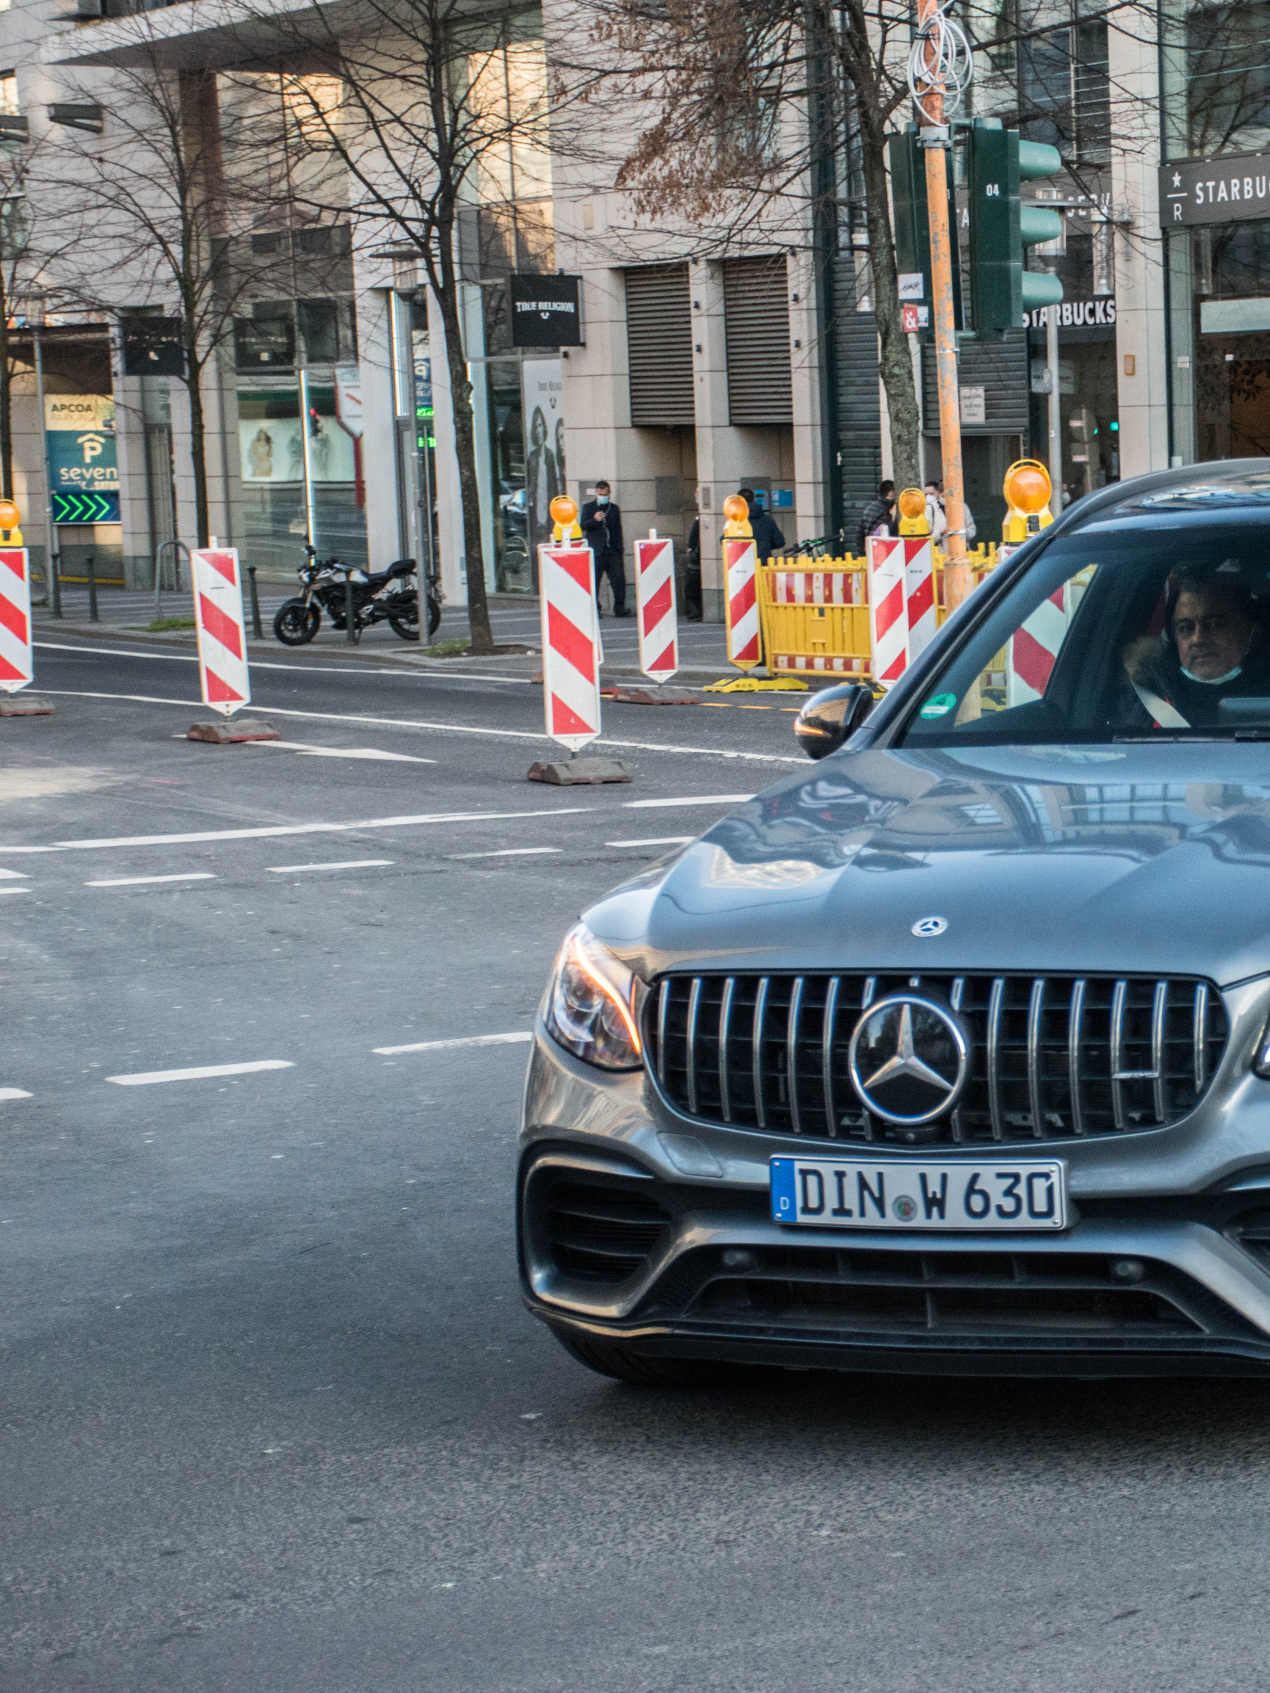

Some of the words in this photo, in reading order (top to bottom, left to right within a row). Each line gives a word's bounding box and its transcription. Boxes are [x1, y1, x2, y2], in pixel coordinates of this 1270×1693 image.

[986, 184, 1000, 197] 04
[1173, 203, 1183, 221] R
[515, 301, 537, 312] TRUE
[538, 301, 575, 313] RELIGION
[51, 404, 93, 412] APCOA
[83, 441, 103, 463] P
[60, 467, 118, 480] seven
[799, 1168, 886, 1219] DIN
[919, 1172, 948, 1220] W
[964, 1172, 1056, 1220] 630
[780, 1197, 790, 1210] D
